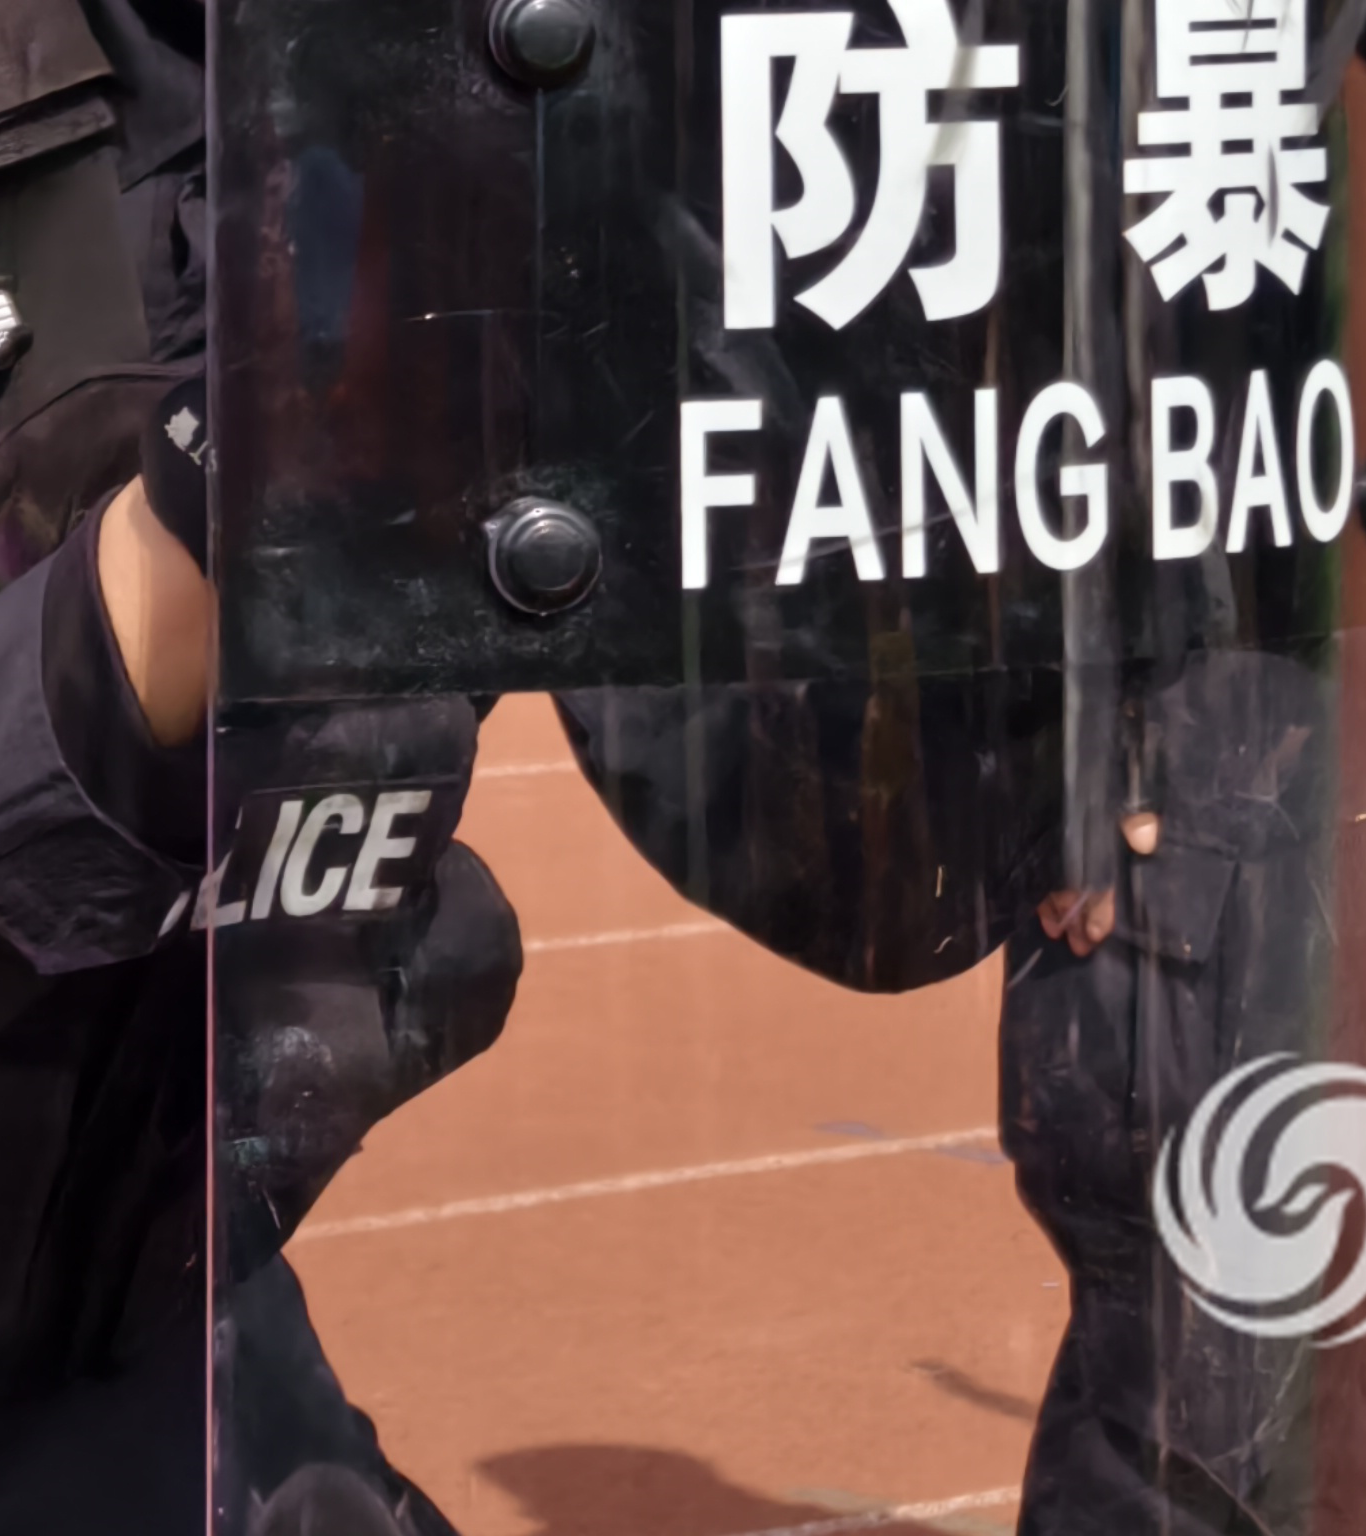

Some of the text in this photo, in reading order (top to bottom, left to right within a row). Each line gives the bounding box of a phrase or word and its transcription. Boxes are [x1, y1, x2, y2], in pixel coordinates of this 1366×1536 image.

[681, 359, 1356, 589] FANG BAO
[158, 790, 433, 938] LICE
